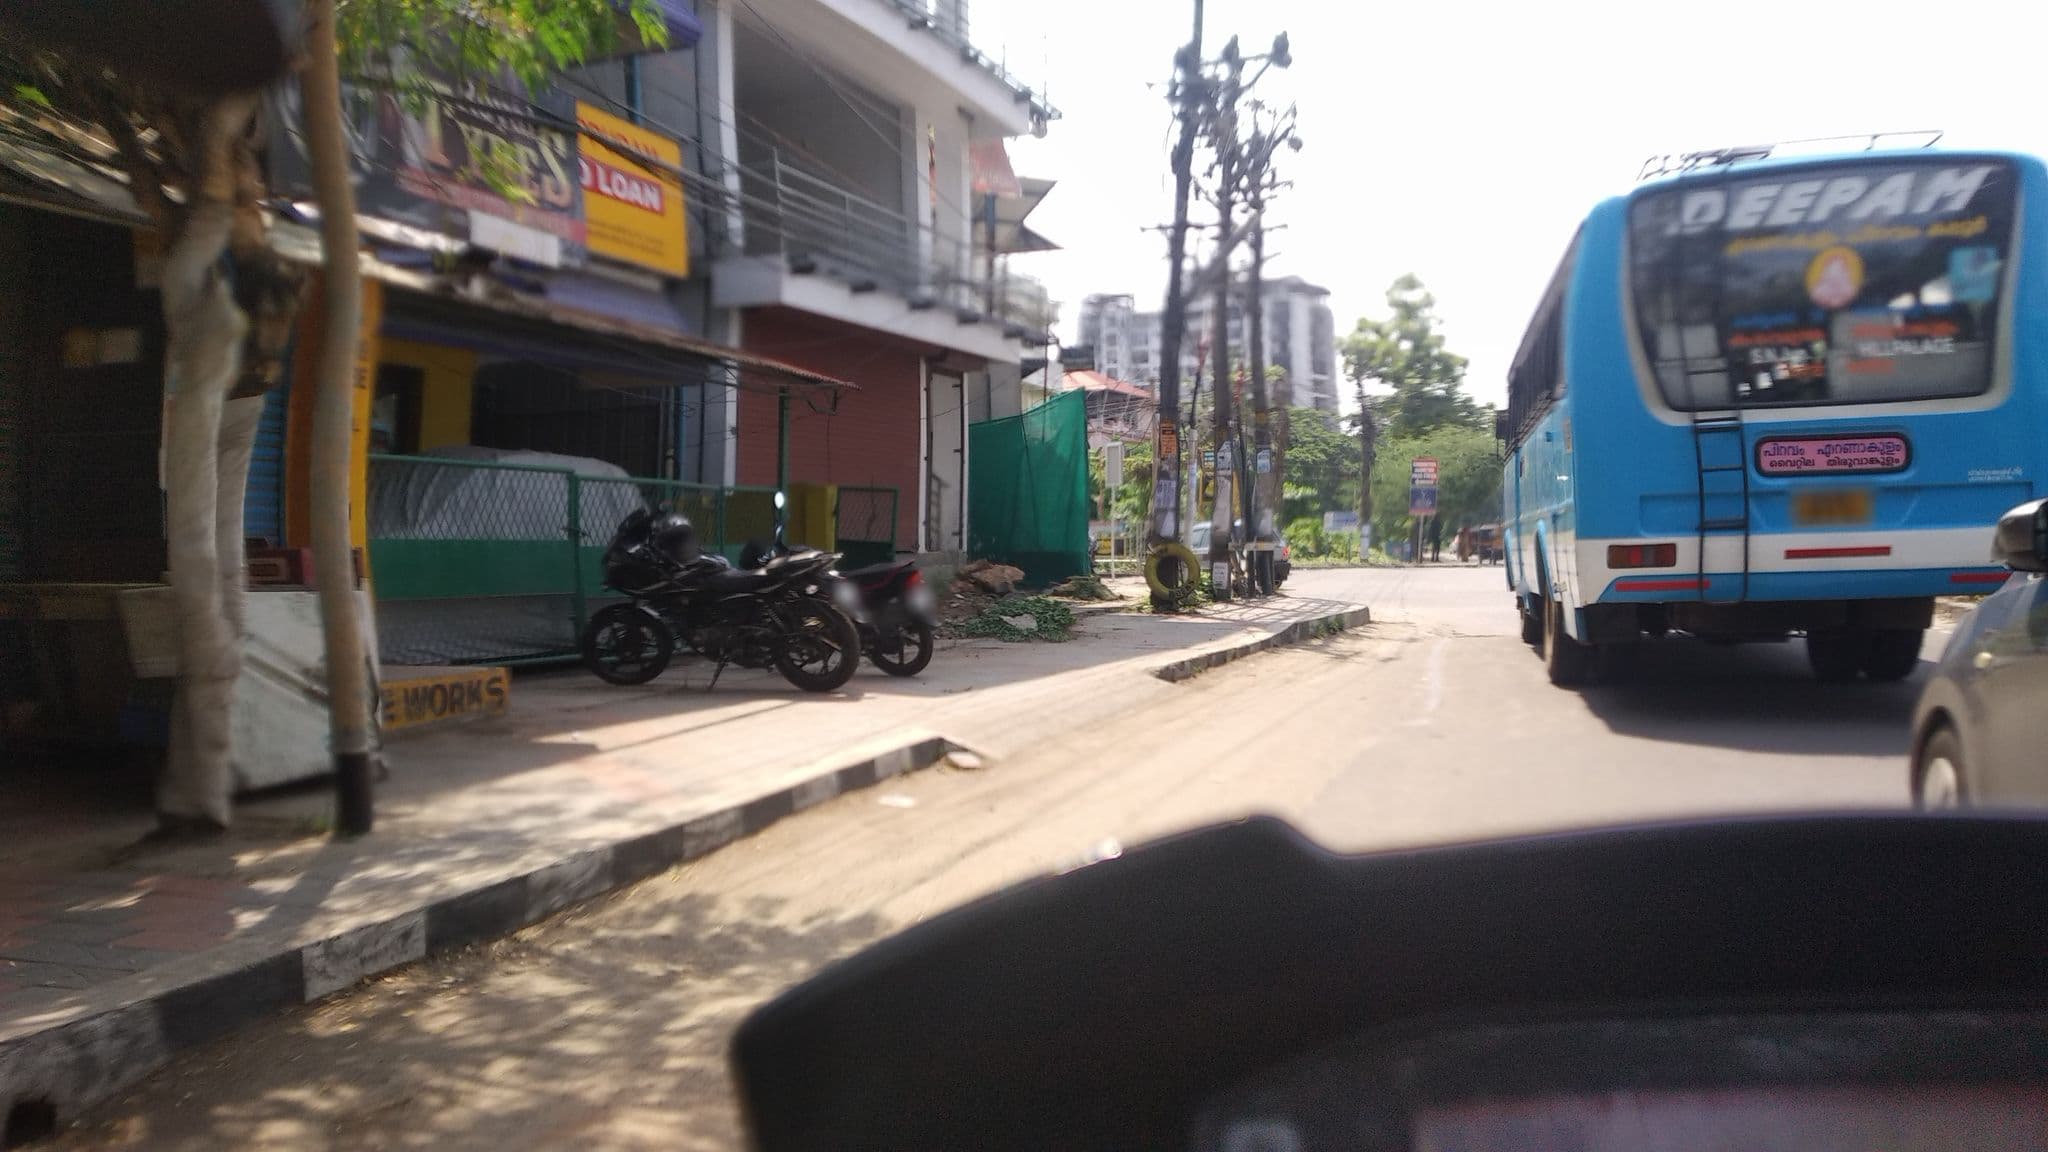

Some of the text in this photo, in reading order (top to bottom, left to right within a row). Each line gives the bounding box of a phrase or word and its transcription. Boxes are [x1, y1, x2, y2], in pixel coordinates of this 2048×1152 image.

[596, 164, 661, 211] LOAN
[1669, 166, 1994, 235] DEEPAM
[1763, 441, 1902, 458] പിറവം എറണാകുളം
[402, 675, 505, 721] WORKS
